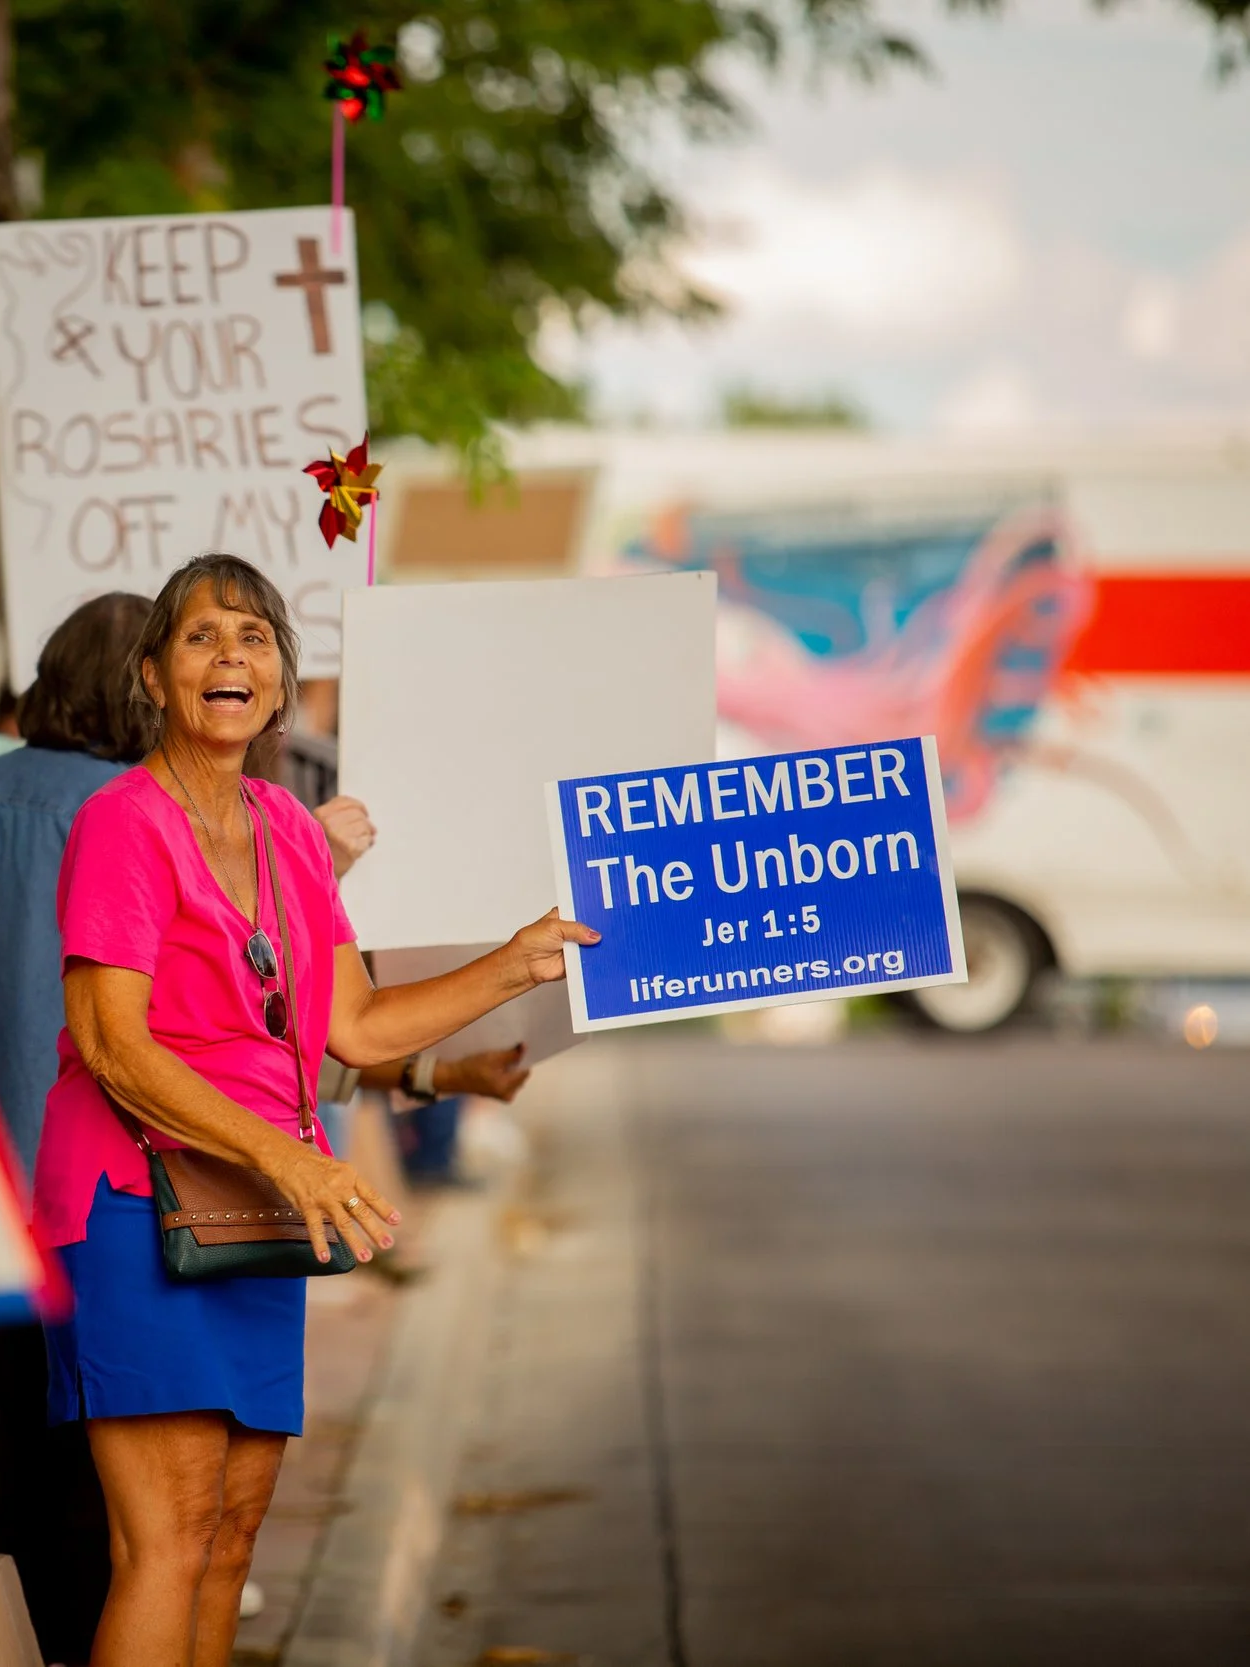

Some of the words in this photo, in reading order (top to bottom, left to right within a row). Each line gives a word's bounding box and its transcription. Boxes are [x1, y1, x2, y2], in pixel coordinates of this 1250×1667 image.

[103, 221, 250, 308] KEEP
[111, 313, 267, 403] YOUR
[12, 394, 350, 479] ROSARIES
[67, 494, 177, 572] OFF
[209, 485, 302, 569] MY
[575, 748, 911, 838] REMEMBER
[586, 854, 694, 910] The
[711, 831, 920, 894] Unborn
[702, 918, 749, 947] Jer
[762, 904, 821, 939] 1:5
[629, 950, 905, 1003] liferunners.org
